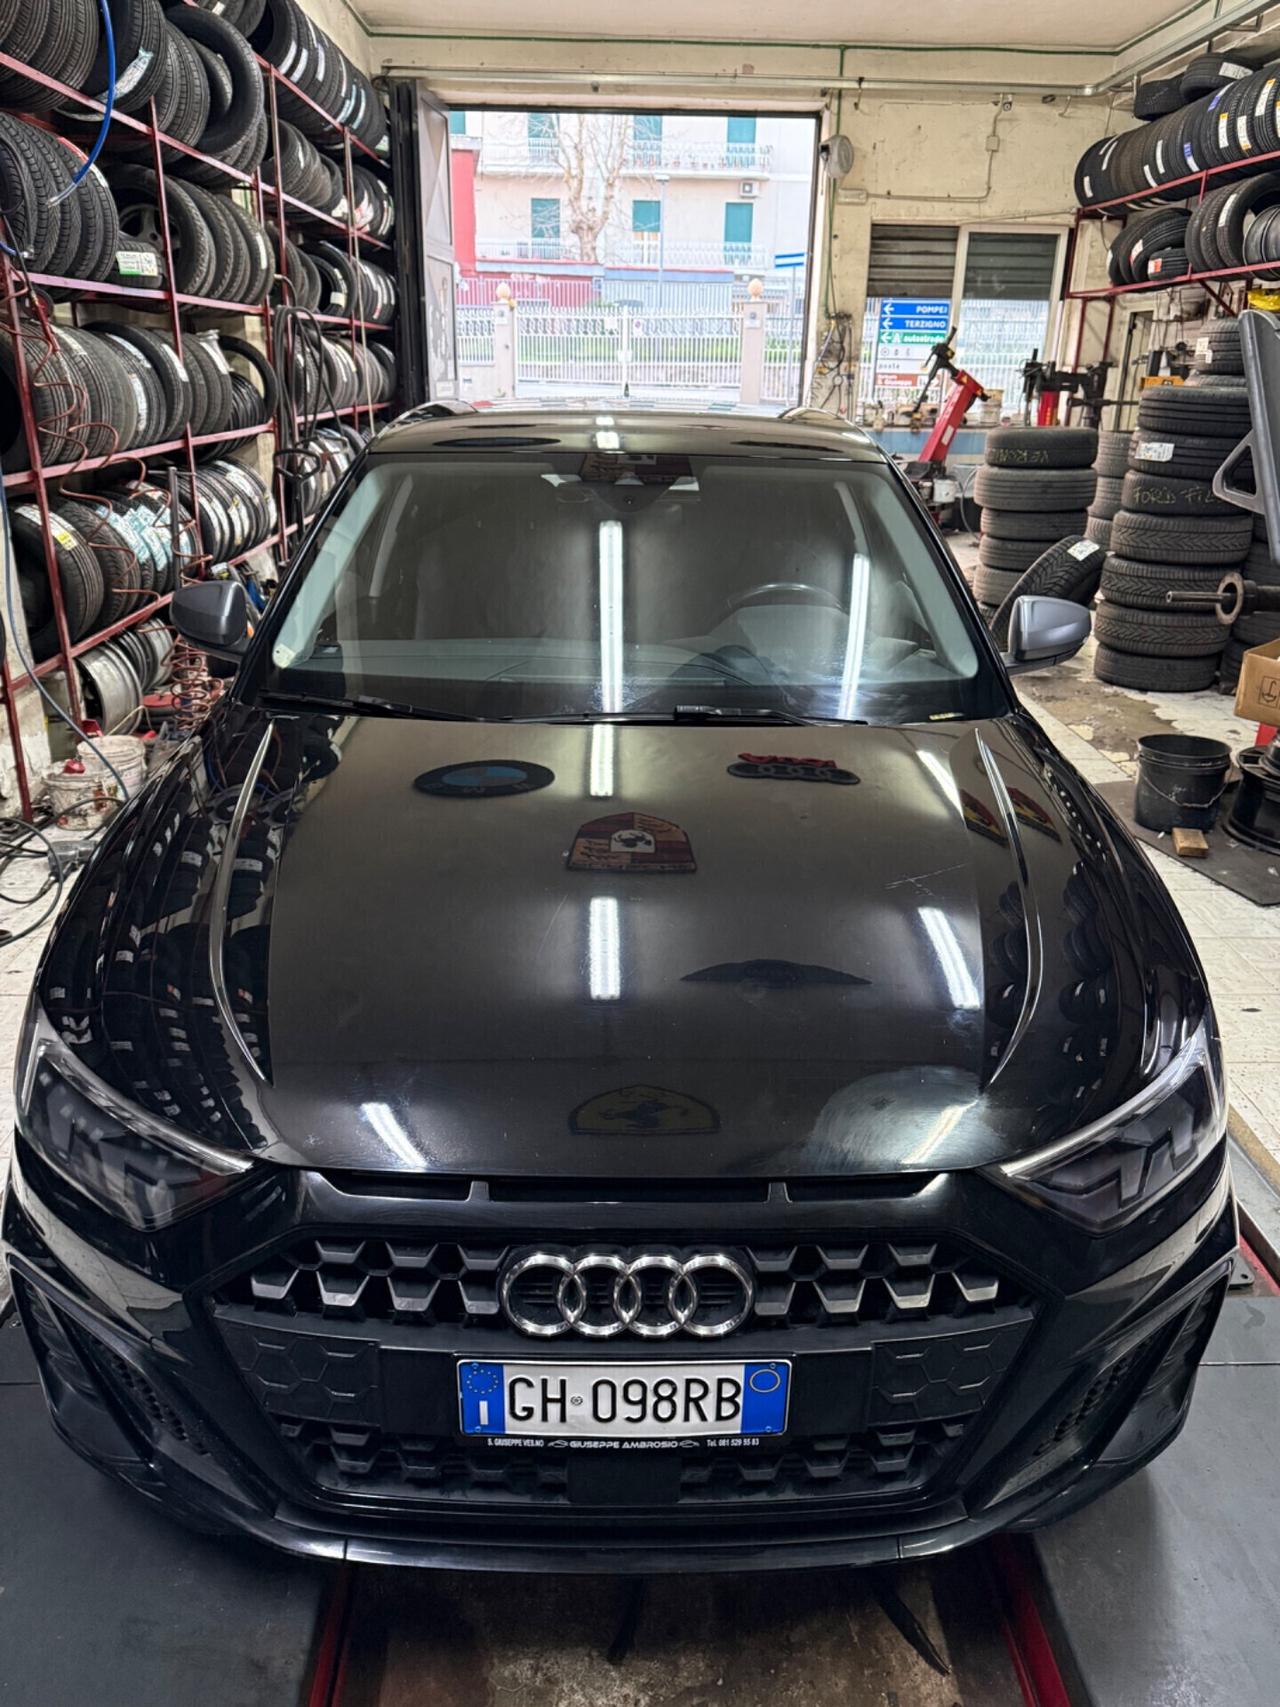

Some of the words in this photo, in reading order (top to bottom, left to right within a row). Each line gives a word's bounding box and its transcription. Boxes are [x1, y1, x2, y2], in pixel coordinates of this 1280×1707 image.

[916, 305, 948, 314] POMPEI
[904, 319, 946, 328] TERZIGNO
[508, 1376, 567, 1423] GH
[592, 1377, 742, 1424] 098RB
[494, 1438, 523, 1446] GIUSEPPE
[569, 1440, 620, 1449] GIUSEPPE
[621, 1440, 679, 1449] AMBROSIO
